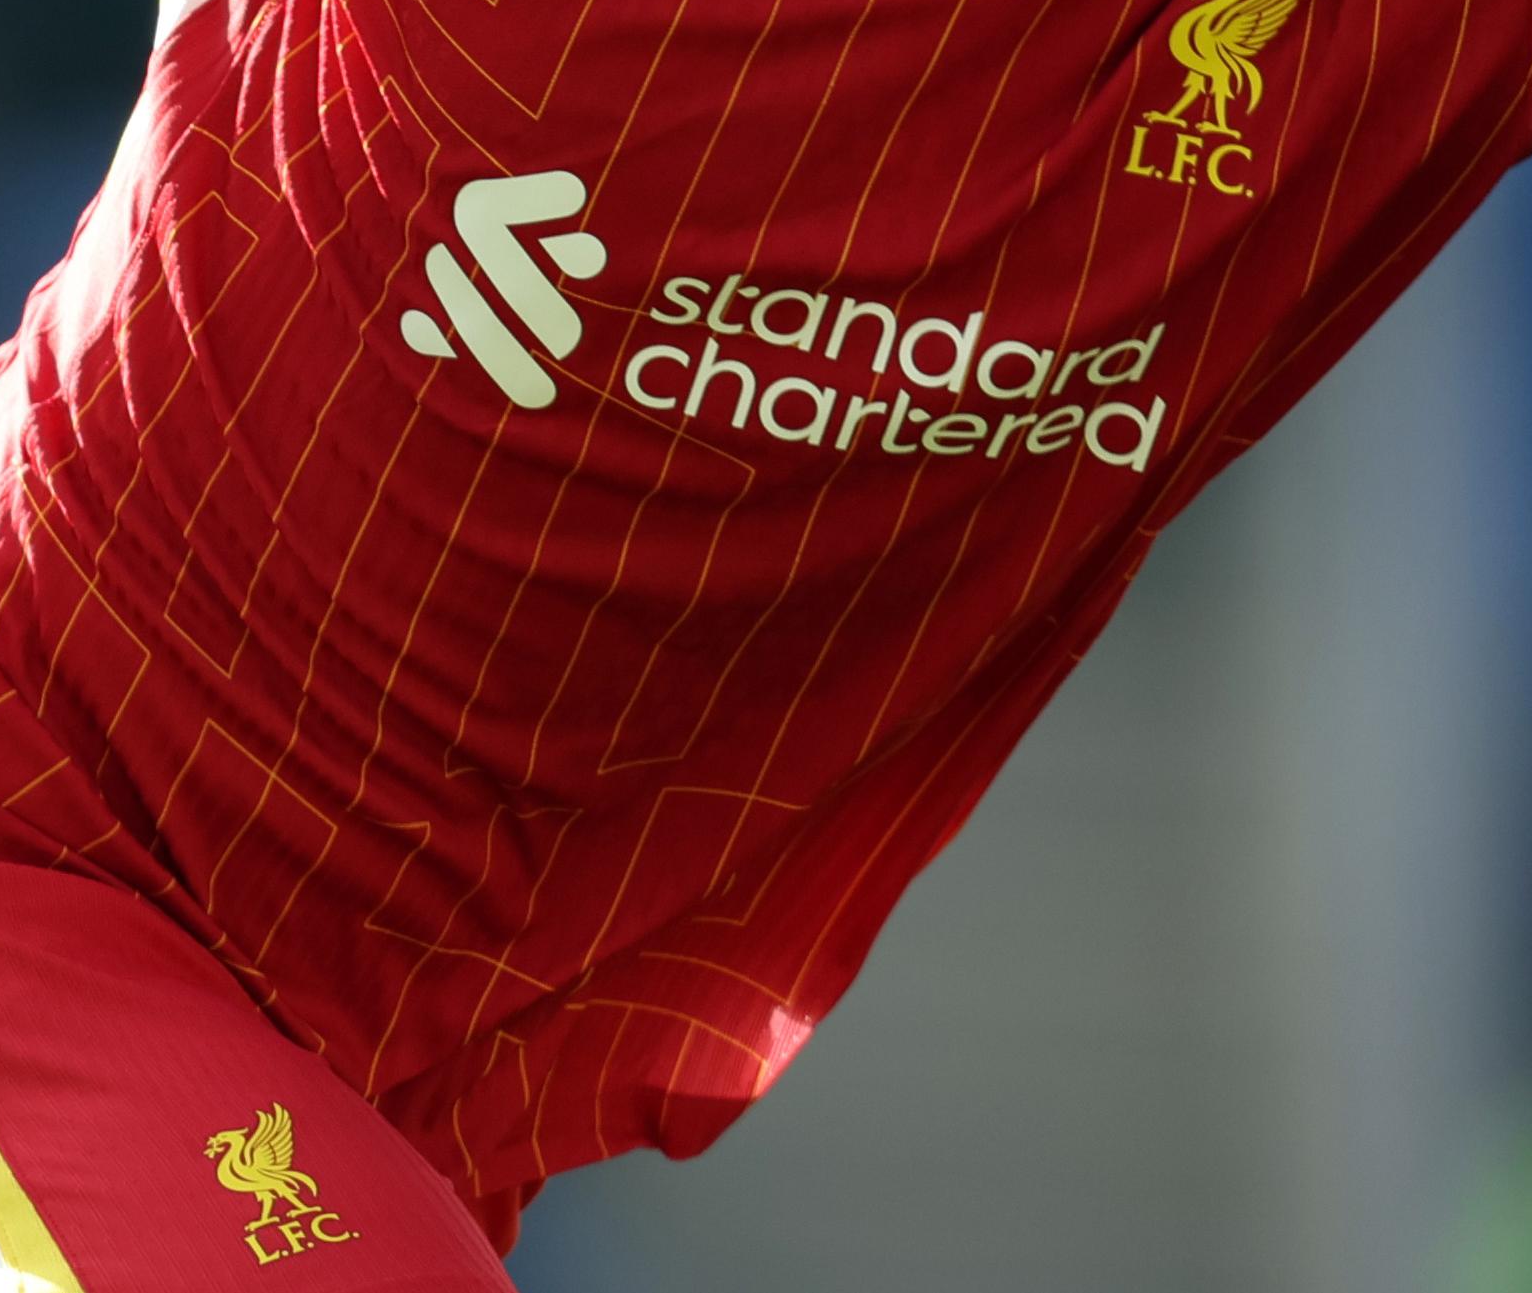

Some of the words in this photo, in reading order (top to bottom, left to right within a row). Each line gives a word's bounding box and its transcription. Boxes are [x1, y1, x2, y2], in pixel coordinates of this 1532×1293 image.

[1123, 124, 1255, 199] L.F.C.
[648, 273, 1166, 400] standard
[623, 336, 1167, 474] chartered
[243, 1212, 361, 1266] L.F.C.
